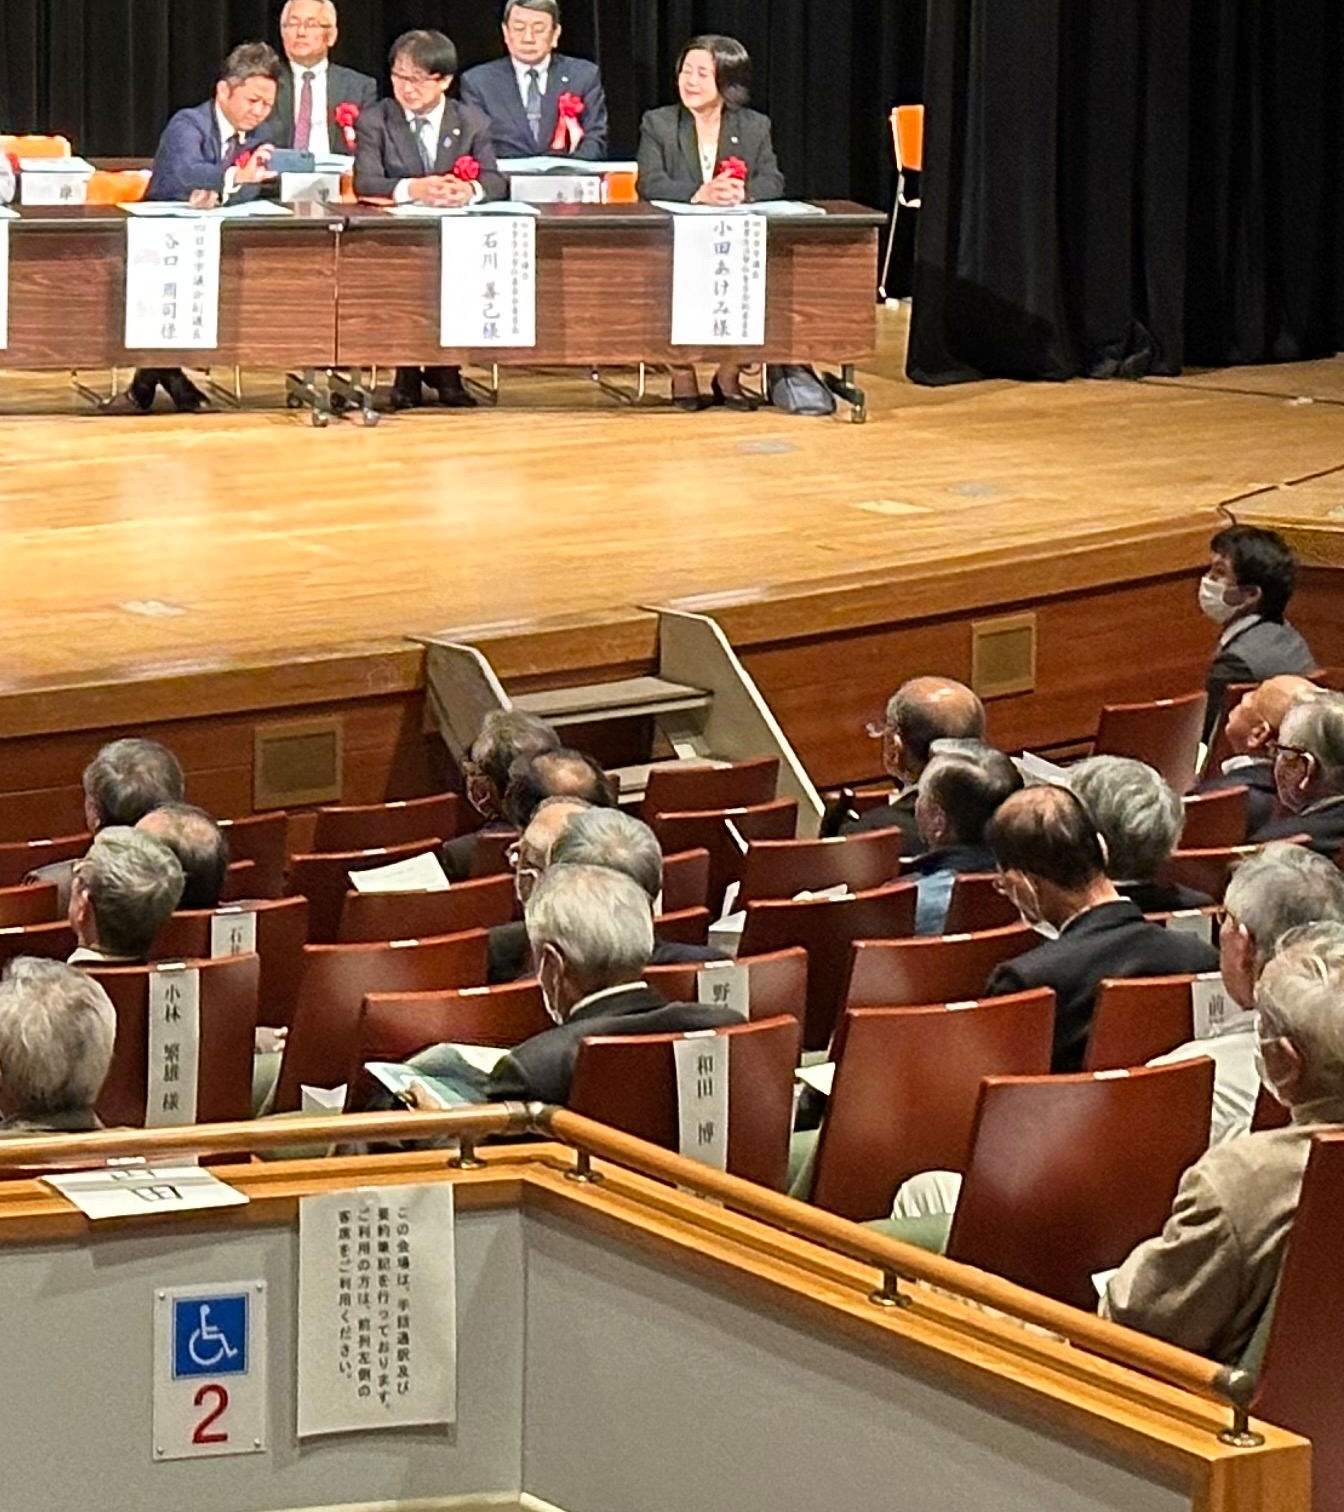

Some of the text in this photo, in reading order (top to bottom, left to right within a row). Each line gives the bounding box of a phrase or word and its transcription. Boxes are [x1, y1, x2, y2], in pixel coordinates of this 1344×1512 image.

[713, 220, 732, 336] 小田あけみ様
[165, 984, 181, 1023] 小林
[193, 1384, 228, 1443] 2
